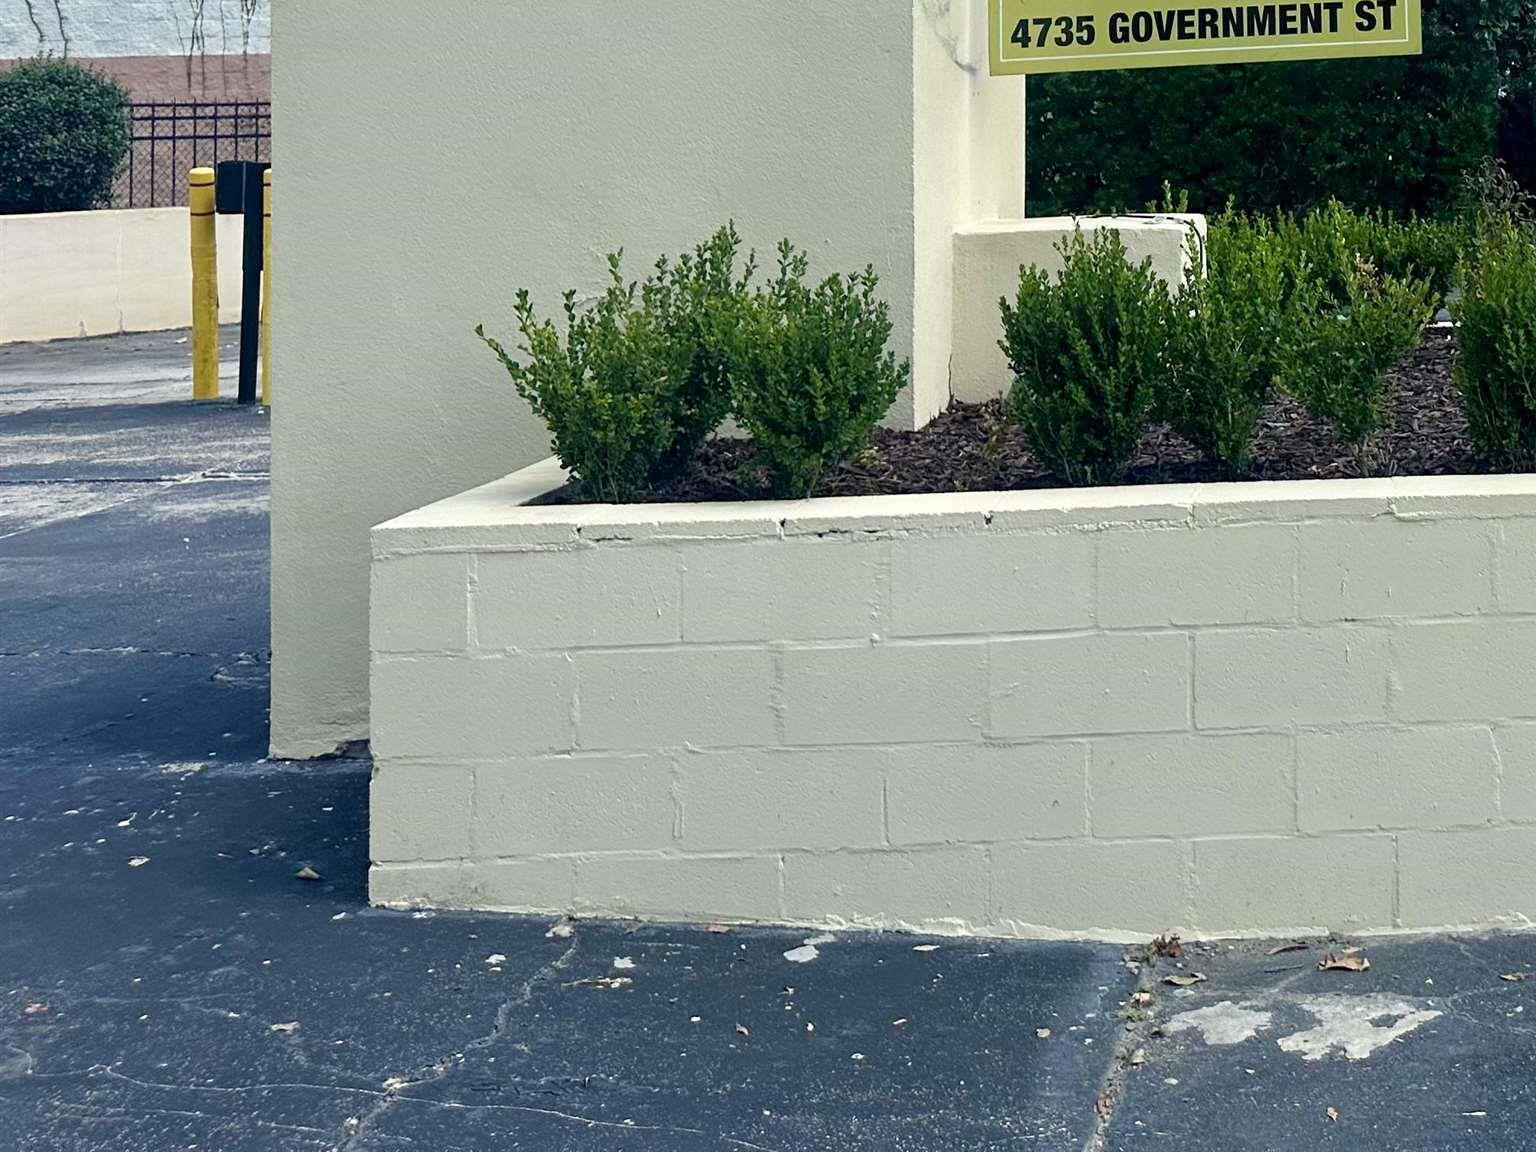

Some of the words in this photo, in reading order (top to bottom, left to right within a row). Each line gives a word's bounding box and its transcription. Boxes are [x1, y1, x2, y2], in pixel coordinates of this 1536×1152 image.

[1011, 15, 1096, 48] 4735
[1109, 2, 1344, 43] GOVERNMENT
[1355, 0, 1397, 32] ST
